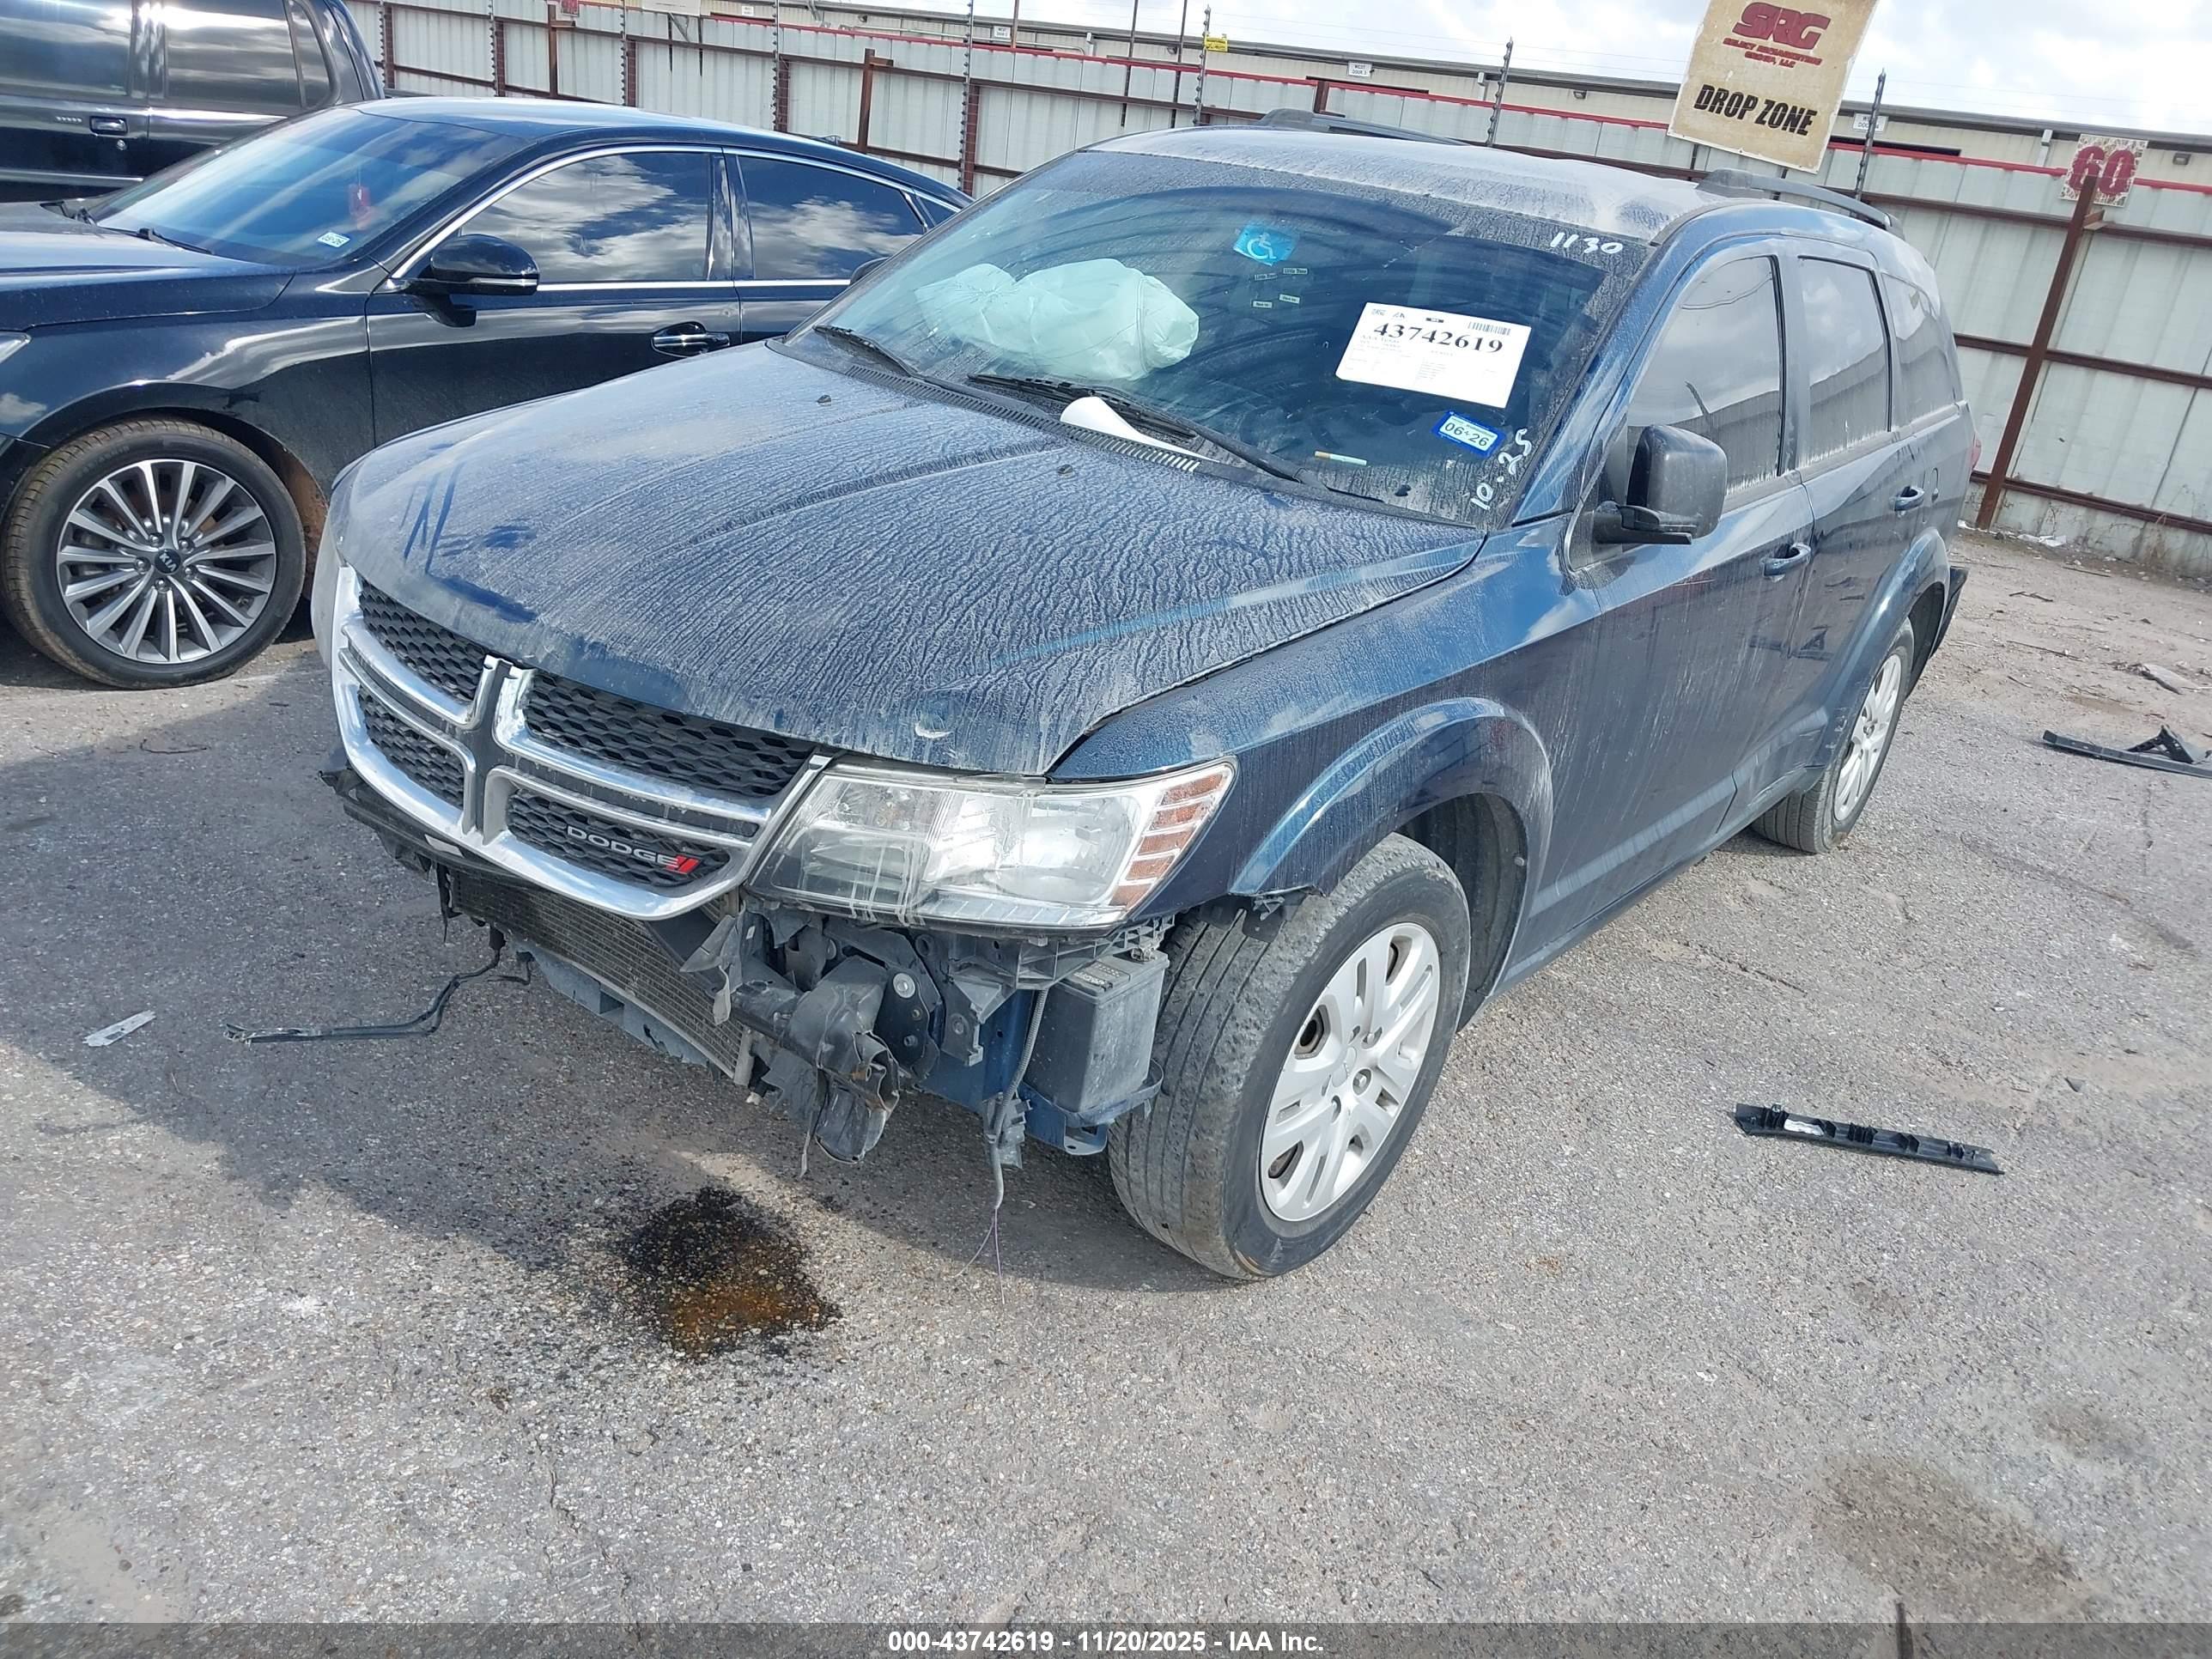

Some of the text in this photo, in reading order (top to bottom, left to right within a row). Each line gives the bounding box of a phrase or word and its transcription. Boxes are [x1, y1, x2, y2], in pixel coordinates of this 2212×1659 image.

[1732, 2, 1831, 50] SRG
[1693, 84, 1818, 136] DROP ZONE
[2069, 145, 2136, 197] 60
[1550, 232, 1624, 254] 1130
[1373, 322, 1503, 354] 43742619
[1444, 422, 1465, 435] 06
[1468, 433, 1490, 447] 26
[159, 552, 177, 572] KIA
[567, 826, 679, 869] DODGE
